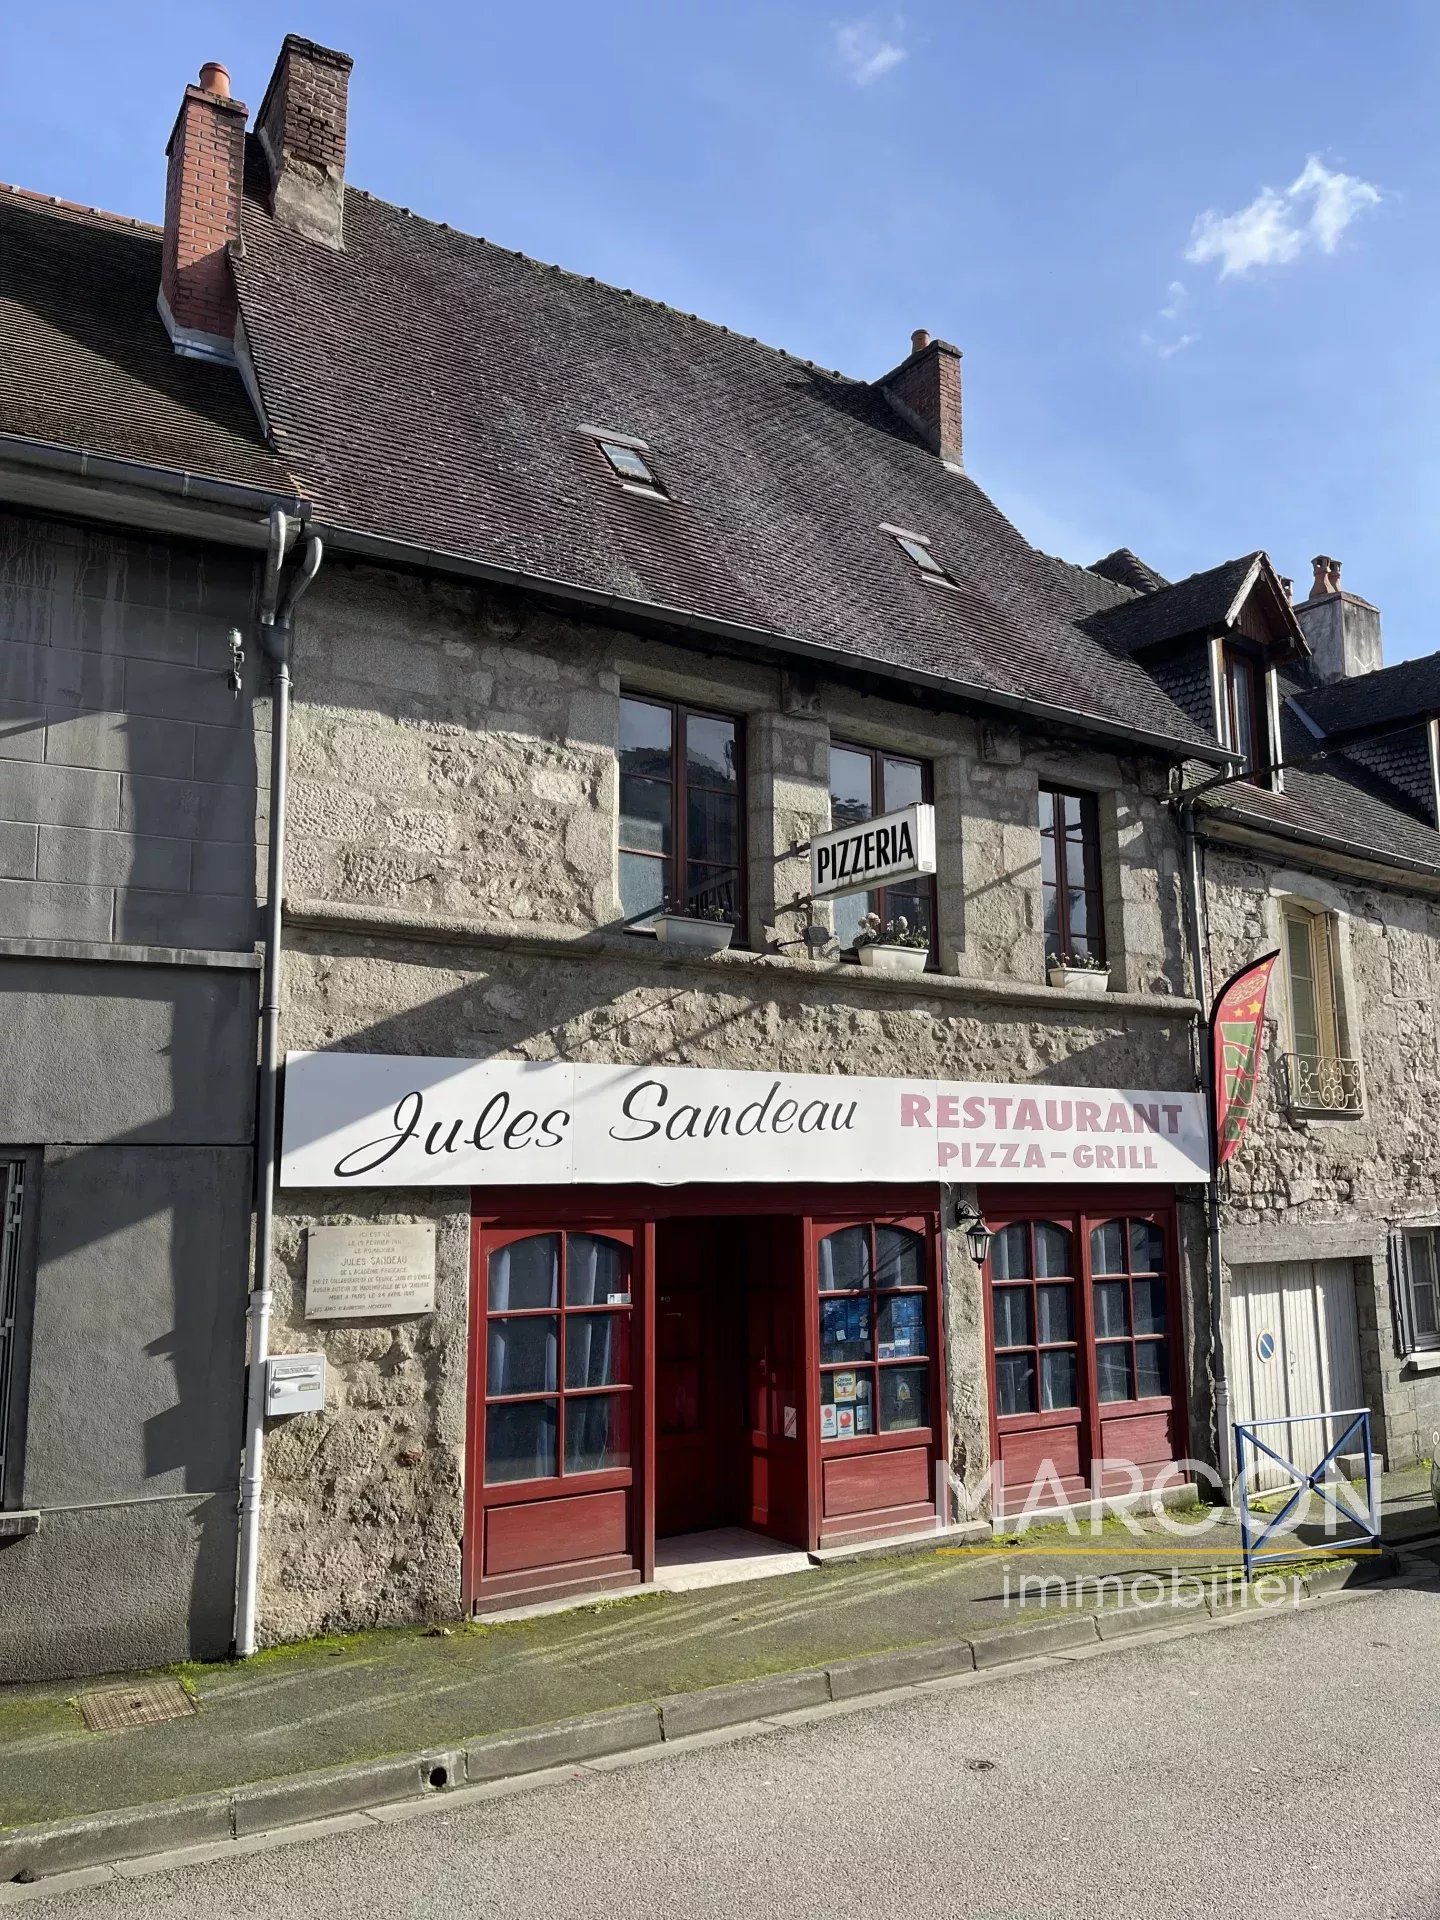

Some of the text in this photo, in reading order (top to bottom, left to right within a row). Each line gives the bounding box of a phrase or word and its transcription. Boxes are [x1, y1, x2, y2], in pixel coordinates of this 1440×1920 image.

[817, 821, 914, 884] PIZZERIA
[1220, 1021, 1258, 1141] PIZZA
[333, 1079, 856, 1177] Jules Sandeau
[900, 1093, 1183, 1134] RESTAURANT
[340, 1255, 408, 1266] JULES SANDEAU
